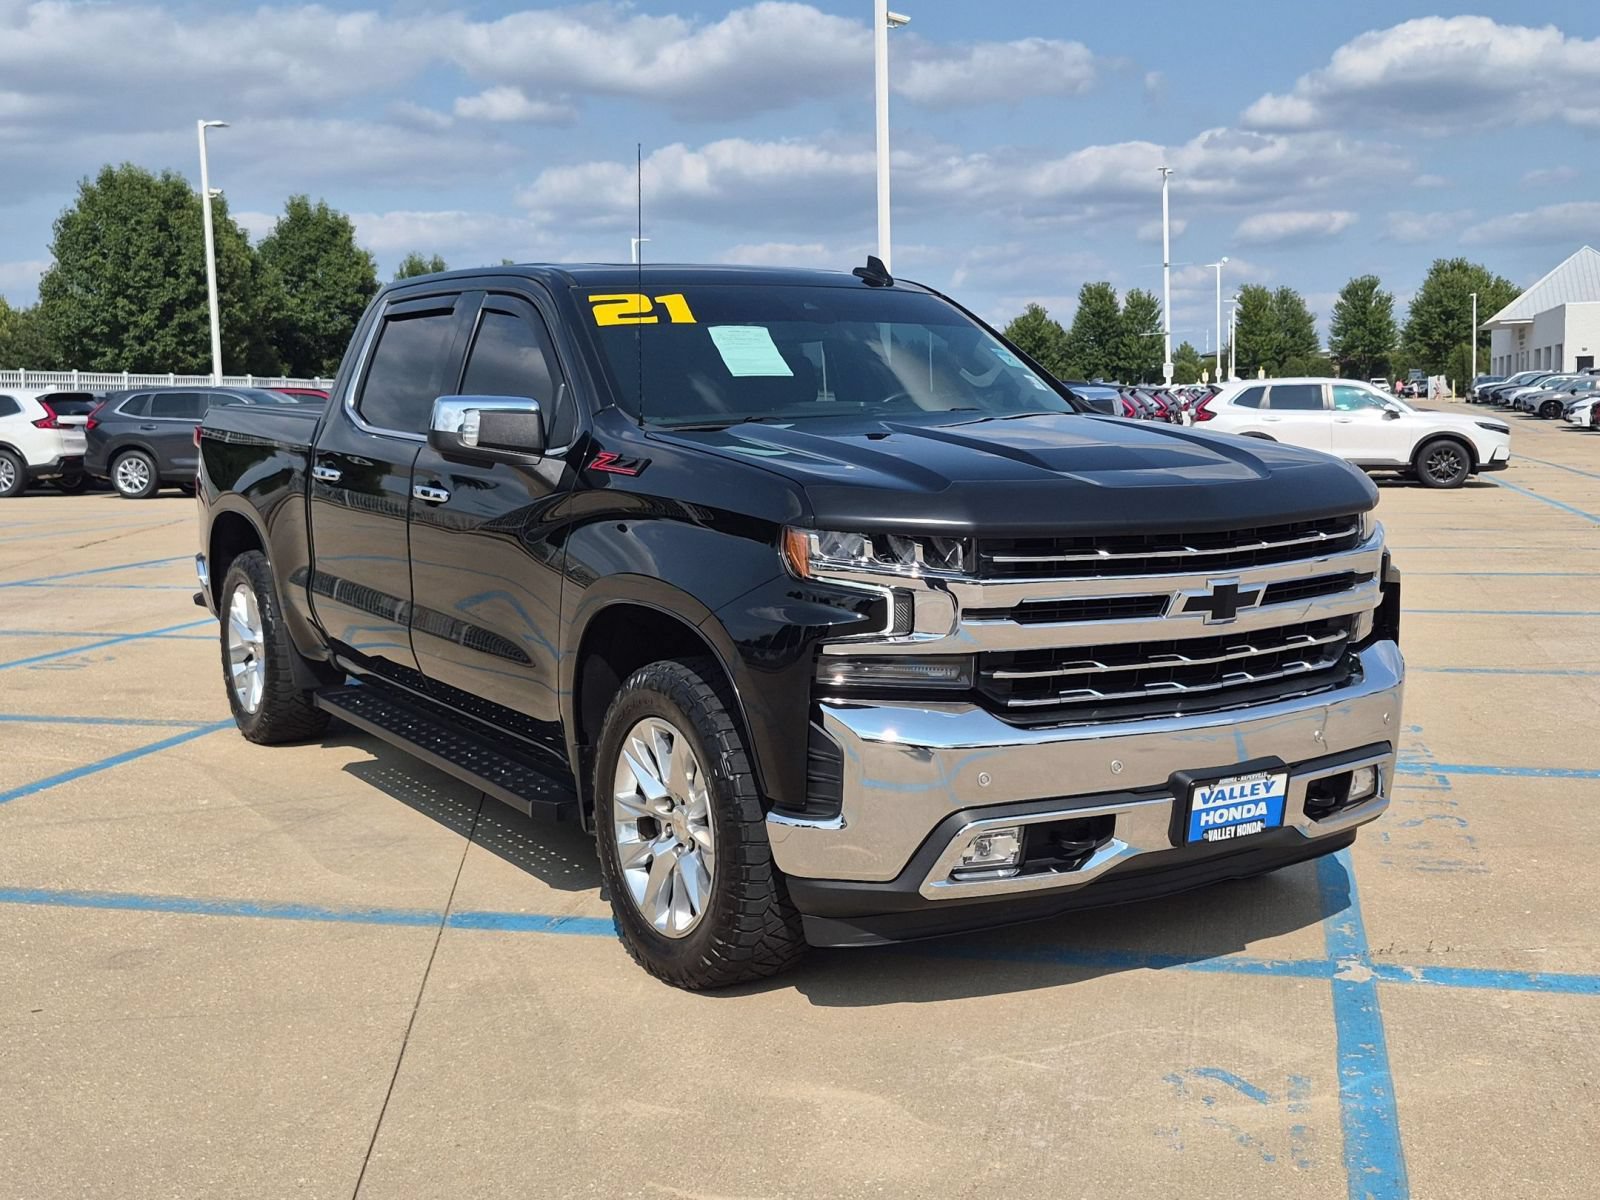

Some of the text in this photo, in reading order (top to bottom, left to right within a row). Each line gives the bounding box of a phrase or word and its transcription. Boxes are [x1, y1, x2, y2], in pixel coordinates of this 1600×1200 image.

[588, 293, 697, 326] 21
[1200, 780, 1276, 805] VALLEY
[1200, 802, 1268, 826] HONDA
[1208, 821, 1261, 842] VALLEY HONDA
